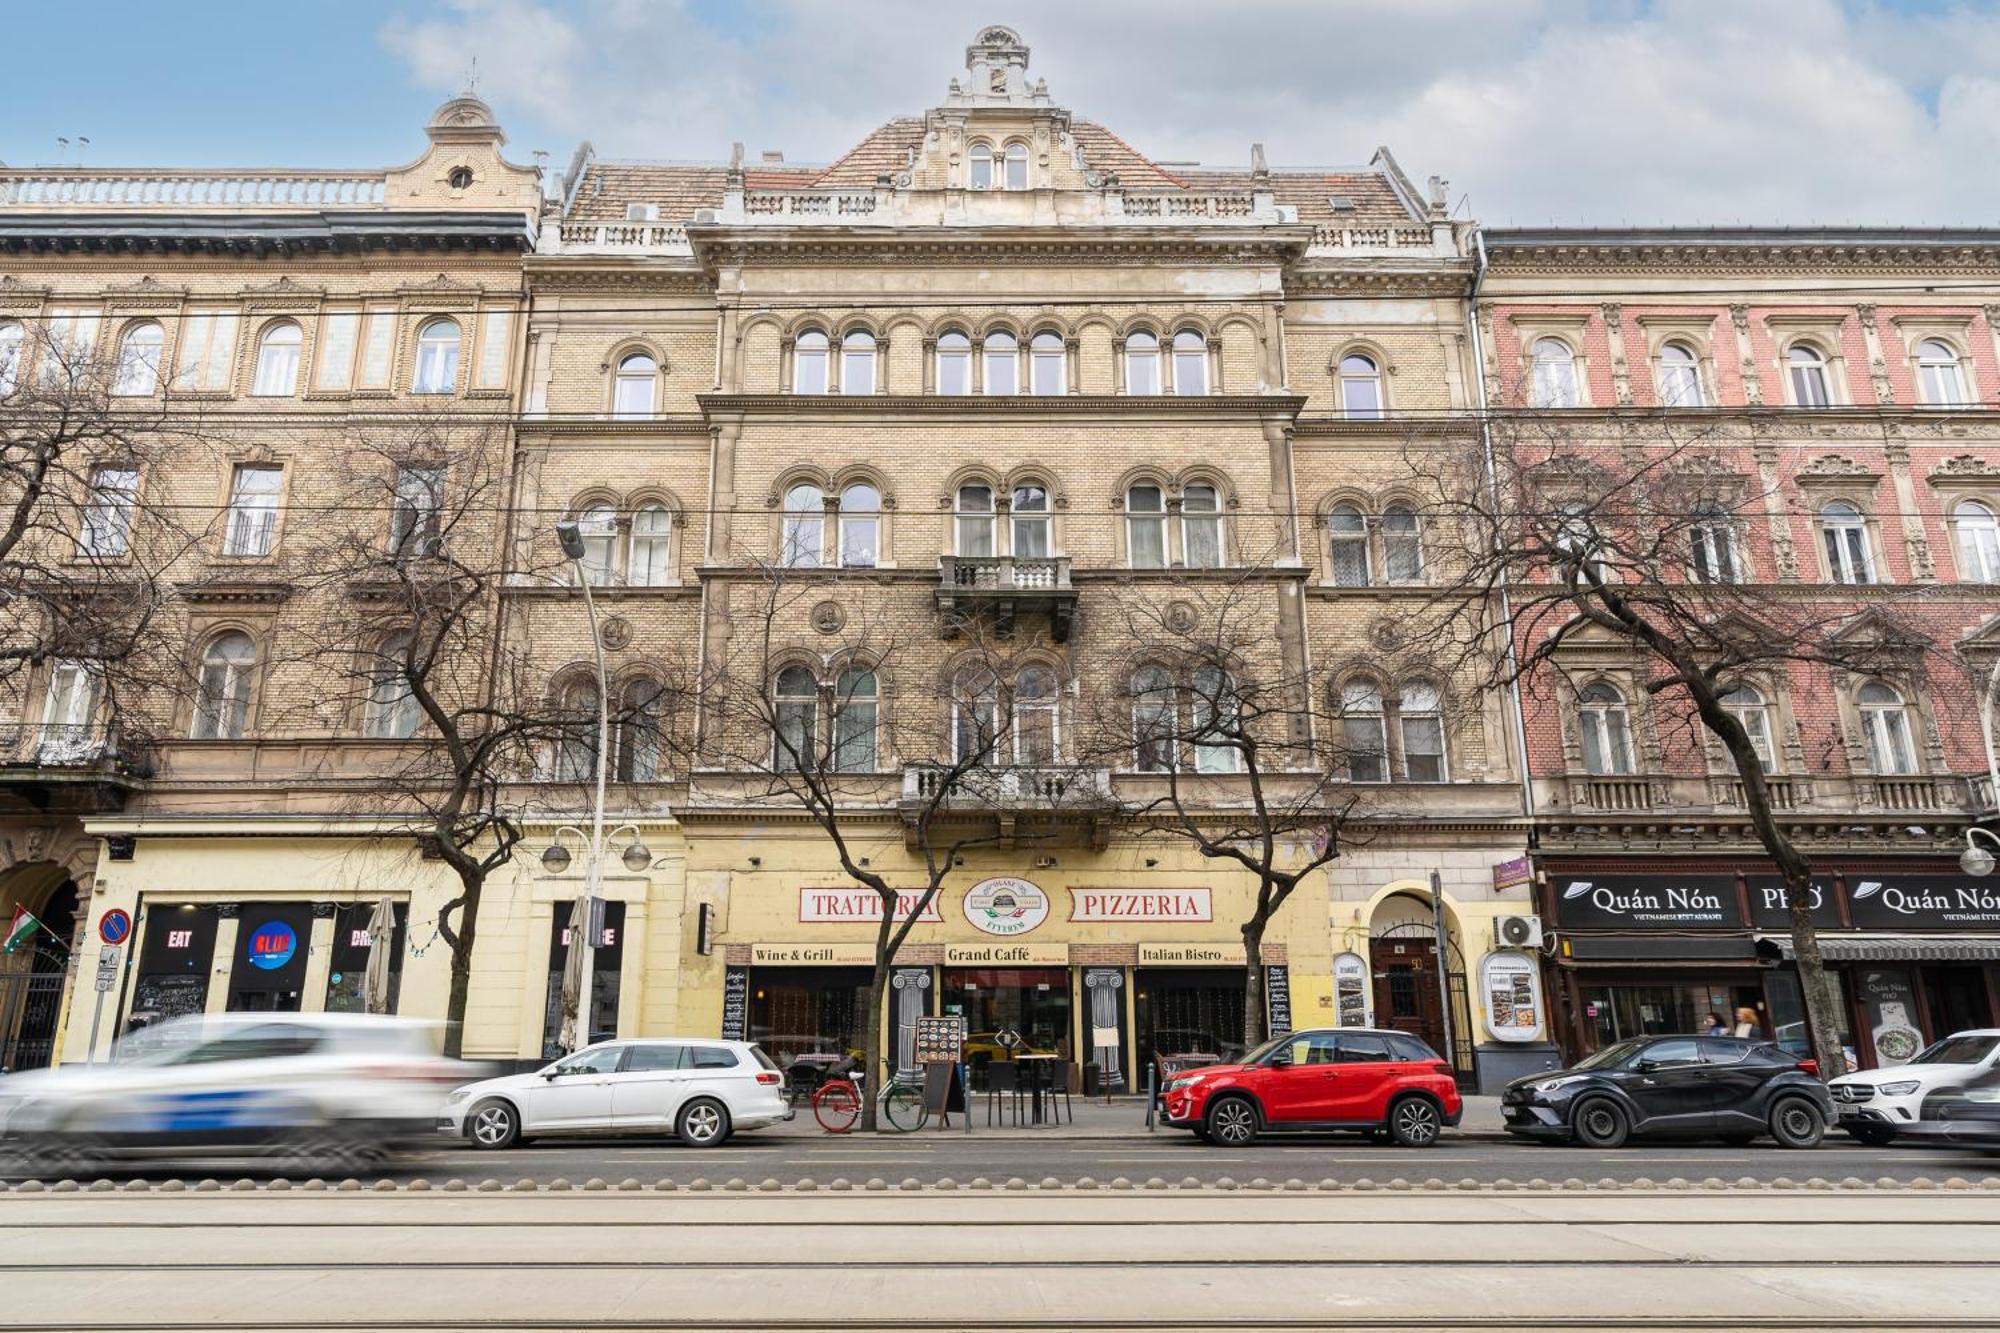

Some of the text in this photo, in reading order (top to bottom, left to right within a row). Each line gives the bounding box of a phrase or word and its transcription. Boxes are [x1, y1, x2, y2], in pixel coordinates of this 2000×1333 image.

[1084, 895, 1199, 915] PIZZERIA
[1592, 888, 1722, 914] Quán Nón
[1882, 888, 1951, 914] Quán
[168, 931, 192, 947] EAT
[255, 935, 290, 953] BLUE
[756, 949, 788, 960] Wine
[791, 950, 800, 960] &
[803, 949, 833, 960] Grill
[948, 948, 991, 961] Grand
[994, 946, 1030, 961] Caffé
[1143, 949, 1182, 960] Italian
[1185, 949, 1222, 960] Bistro
